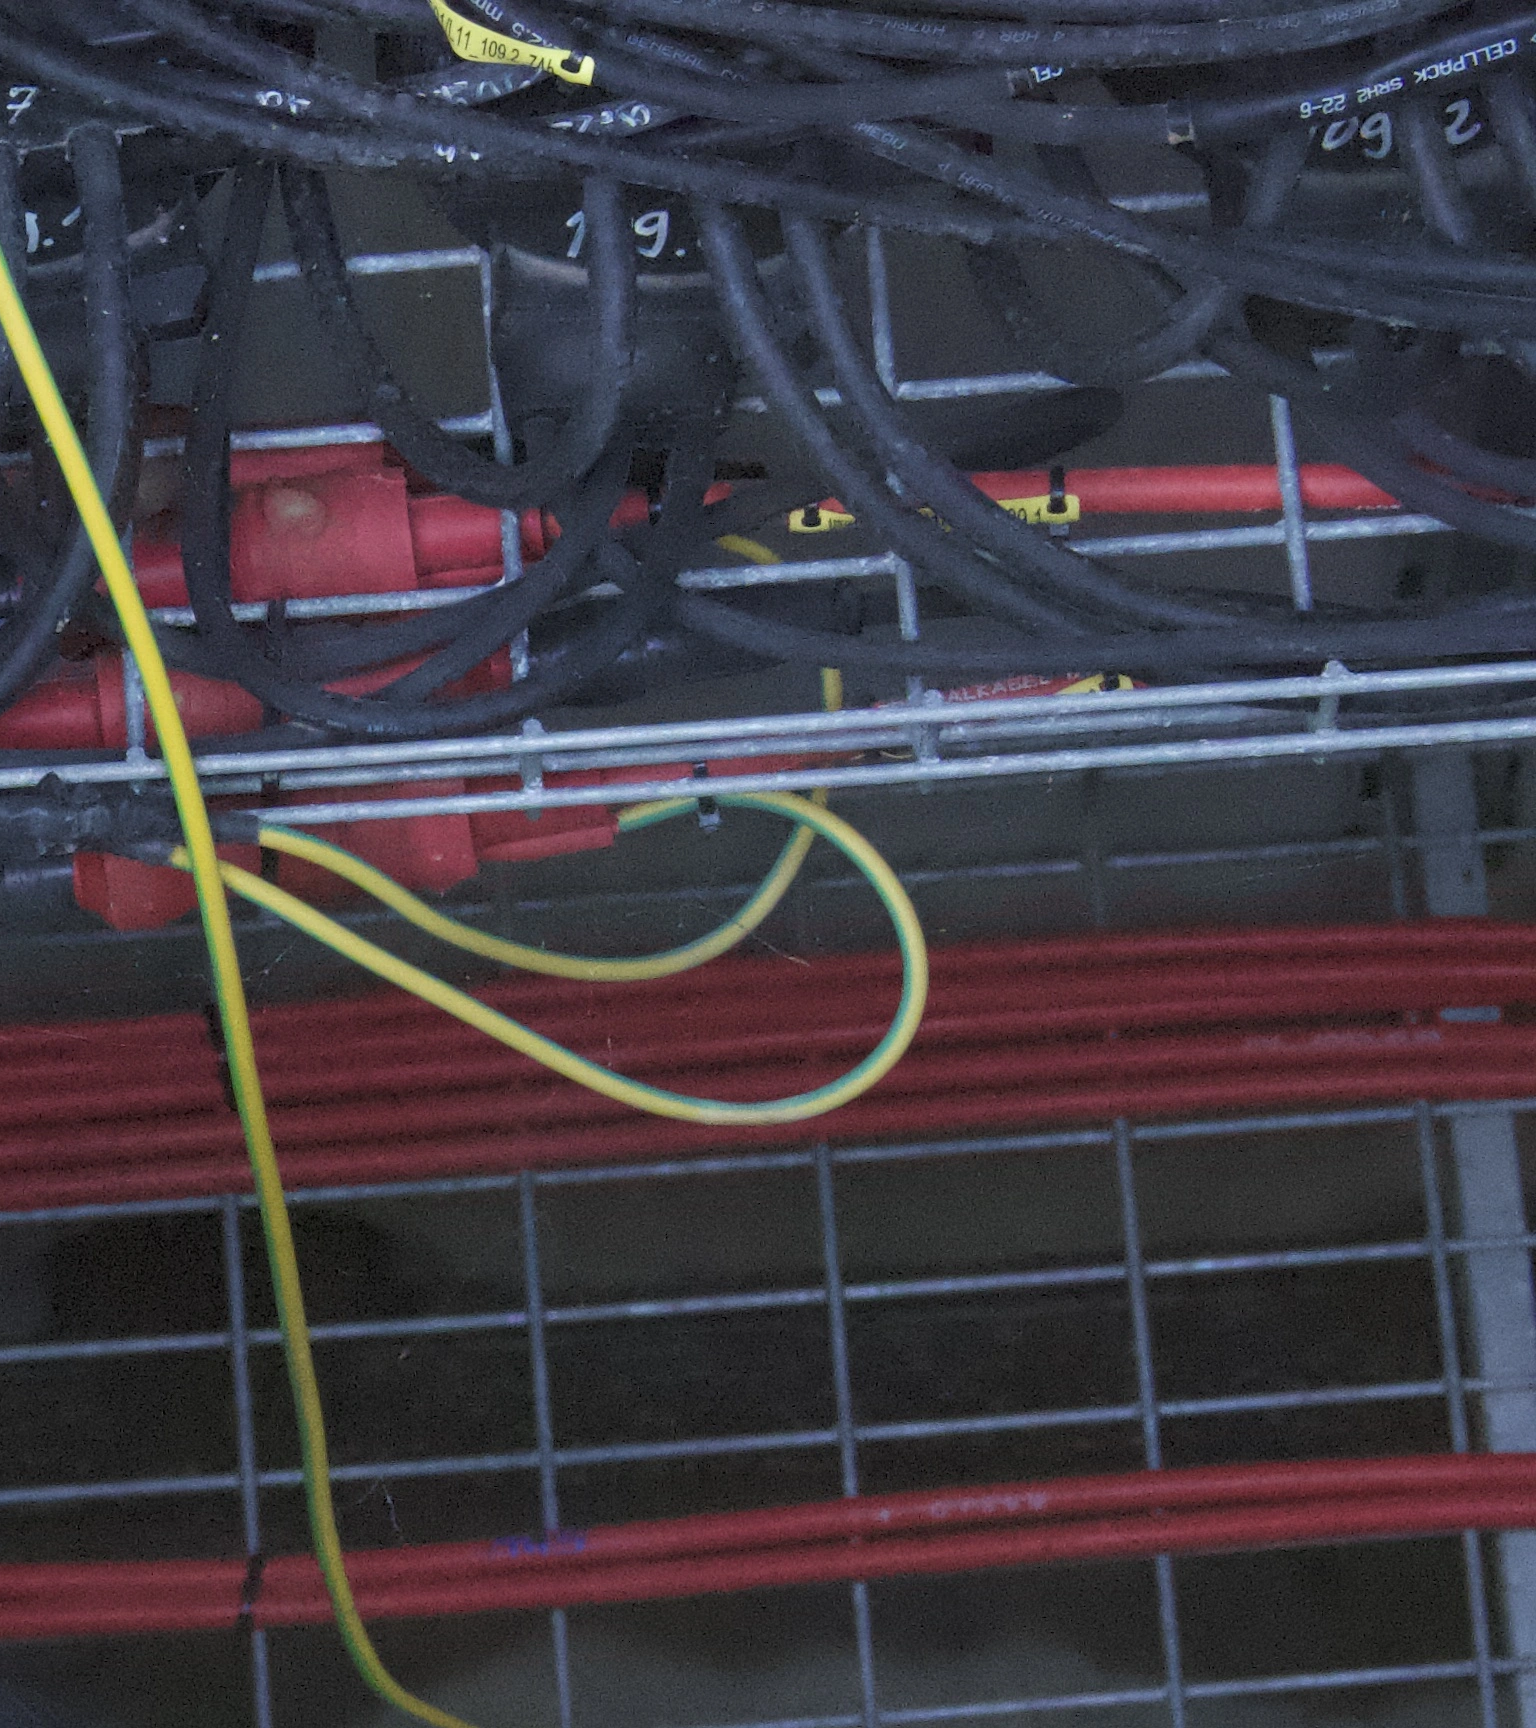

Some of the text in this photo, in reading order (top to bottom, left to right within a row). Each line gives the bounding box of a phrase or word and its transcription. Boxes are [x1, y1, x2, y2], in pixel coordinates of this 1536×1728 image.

[1299, 38, 1518, 119] CELLPACK SRH2 22-6
